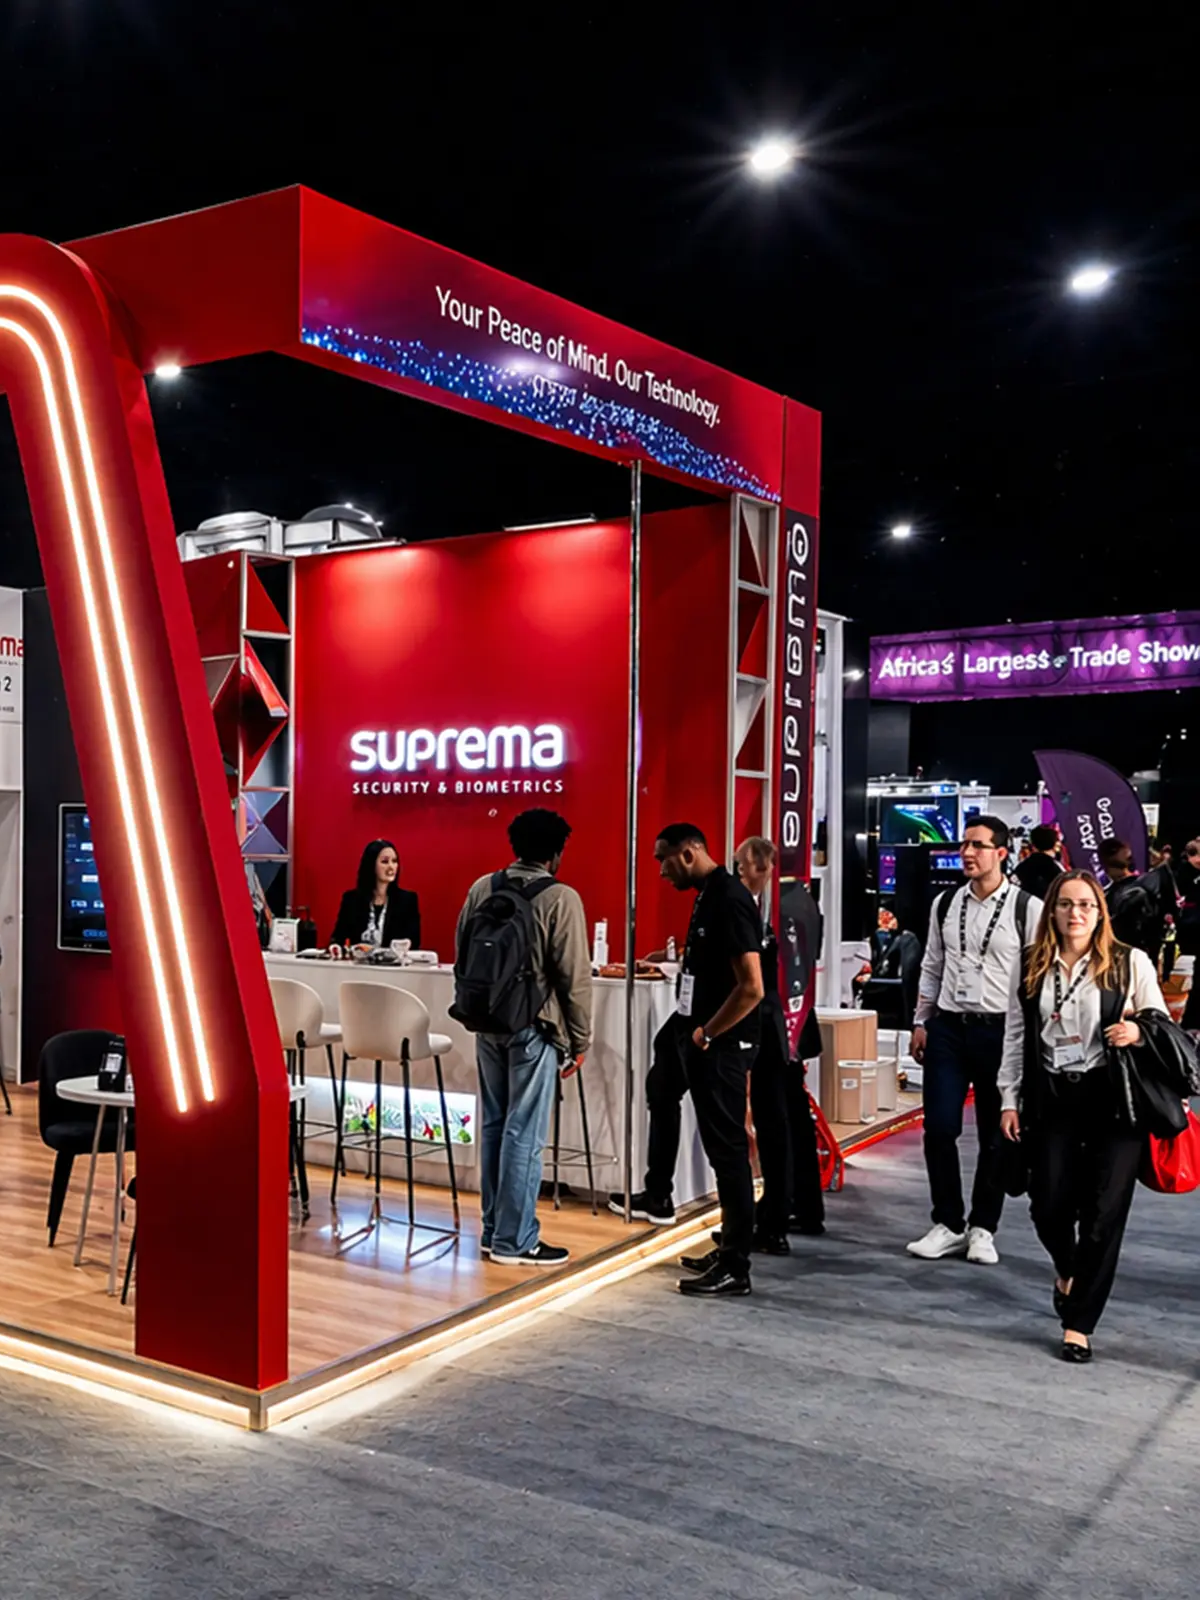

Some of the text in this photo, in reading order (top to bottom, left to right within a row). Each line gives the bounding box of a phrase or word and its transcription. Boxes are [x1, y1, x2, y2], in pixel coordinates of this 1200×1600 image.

[435, 285, 483, 329] Your
[488, 305, 542, 353] Peace
[546, 335, 565, 363] of
[615, 359, 642, 392] Our
[645, 370, 720, 428] Technology.
[1070, 643, 1131, 668] Trade
[4, 676, 12, 692] 2
[351, 724, 564, 771] suprema
[352, 780, 563, 795] SECURITY & BIOMETRICS
